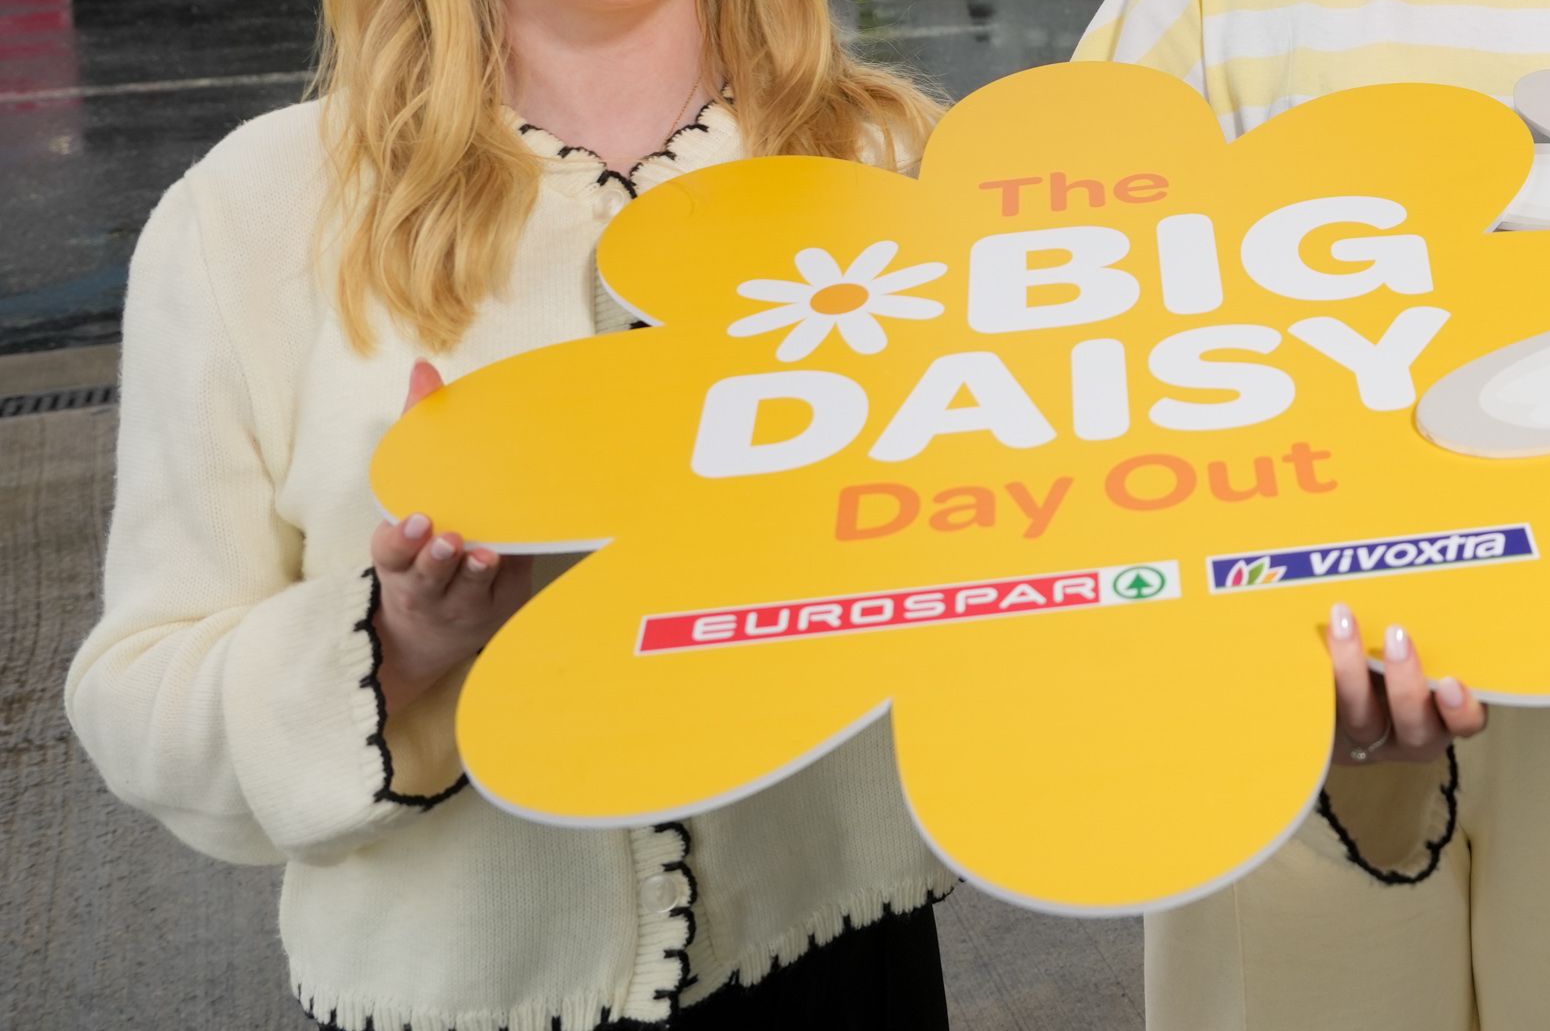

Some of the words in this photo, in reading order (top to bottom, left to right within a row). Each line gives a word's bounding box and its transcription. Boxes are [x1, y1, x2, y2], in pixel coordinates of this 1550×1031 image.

[978, 171, 1170, 218] The
[967, 195, 1434, 334] BIG
[690, 305, 1452, 479] DAISY
[834, 473, 1074, 541] Day
[1103, 441, 1339, 516] Out
[692, 576, 1096, 642] EUROSPAR
